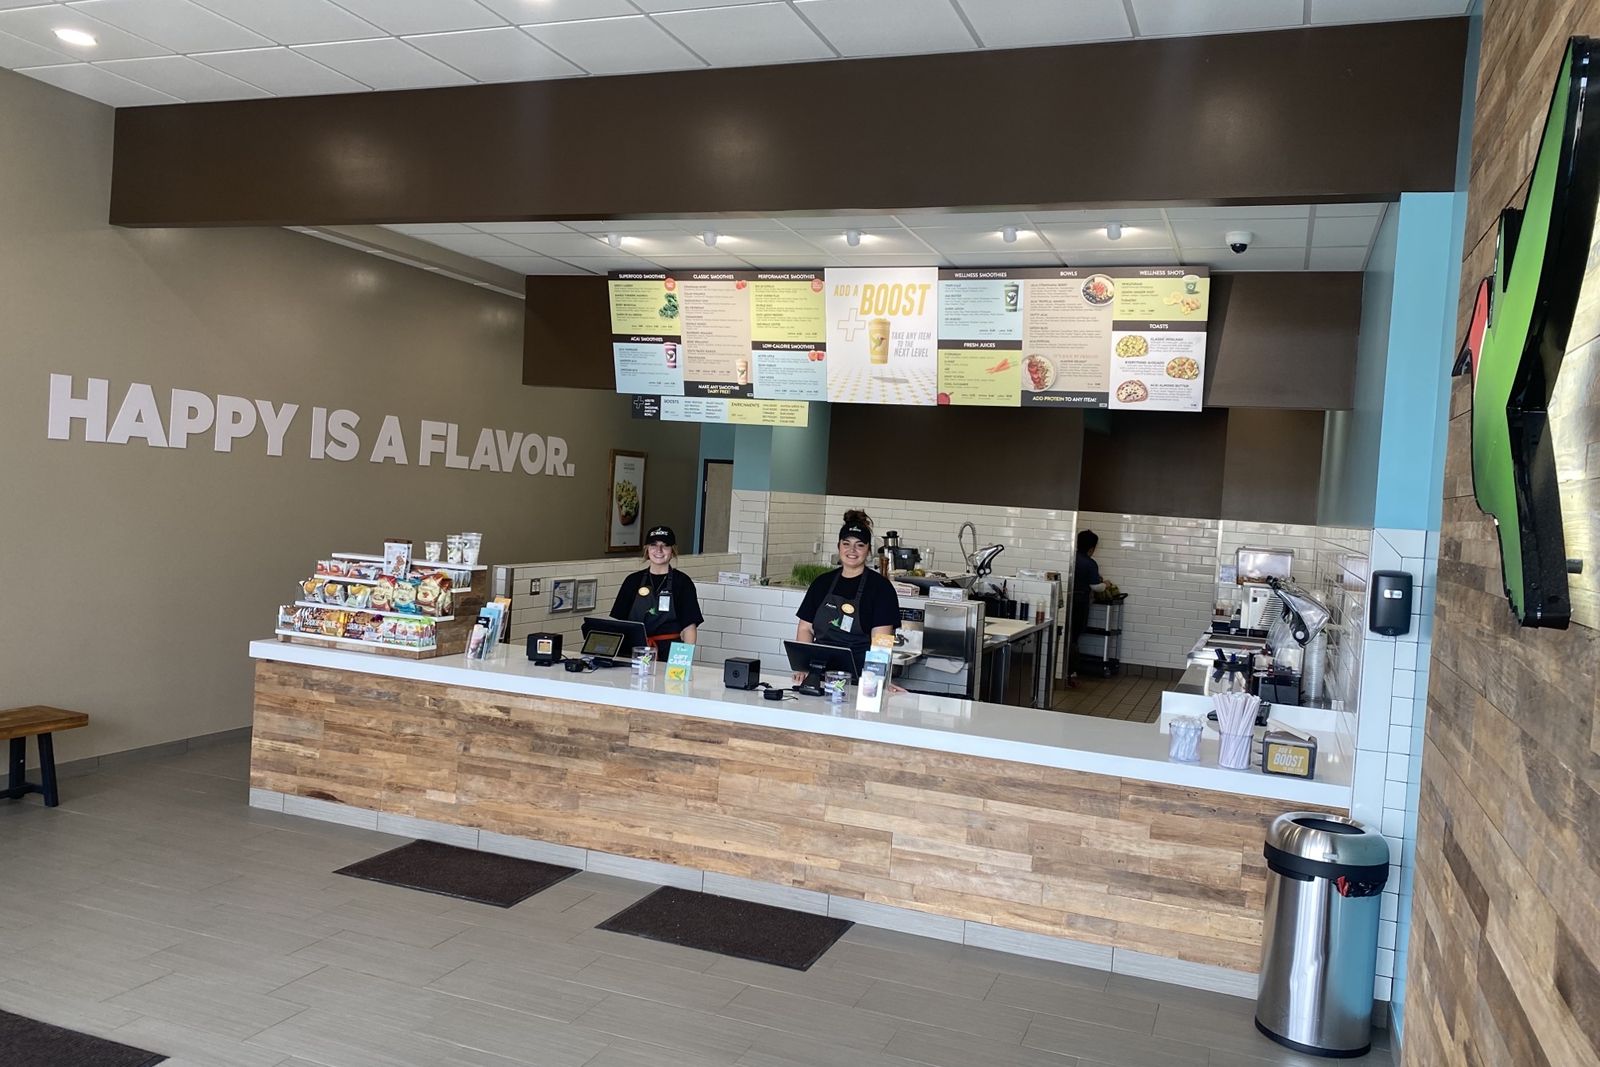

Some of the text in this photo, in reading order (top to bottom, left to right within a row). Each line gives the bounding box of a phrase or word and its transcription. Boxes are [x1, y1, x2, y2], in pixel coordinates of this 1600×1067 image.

[833, 283, 931, 316] ADD A BOOST
[892, 331, 932, 340] TAKE ANY ITEM
[894, 348, 929, 358] NEXT LEVEL
[48, 373, 575, 478] HAPPY IS A FLAVOR.
[1273, 752, 1304, 767] BOOST
